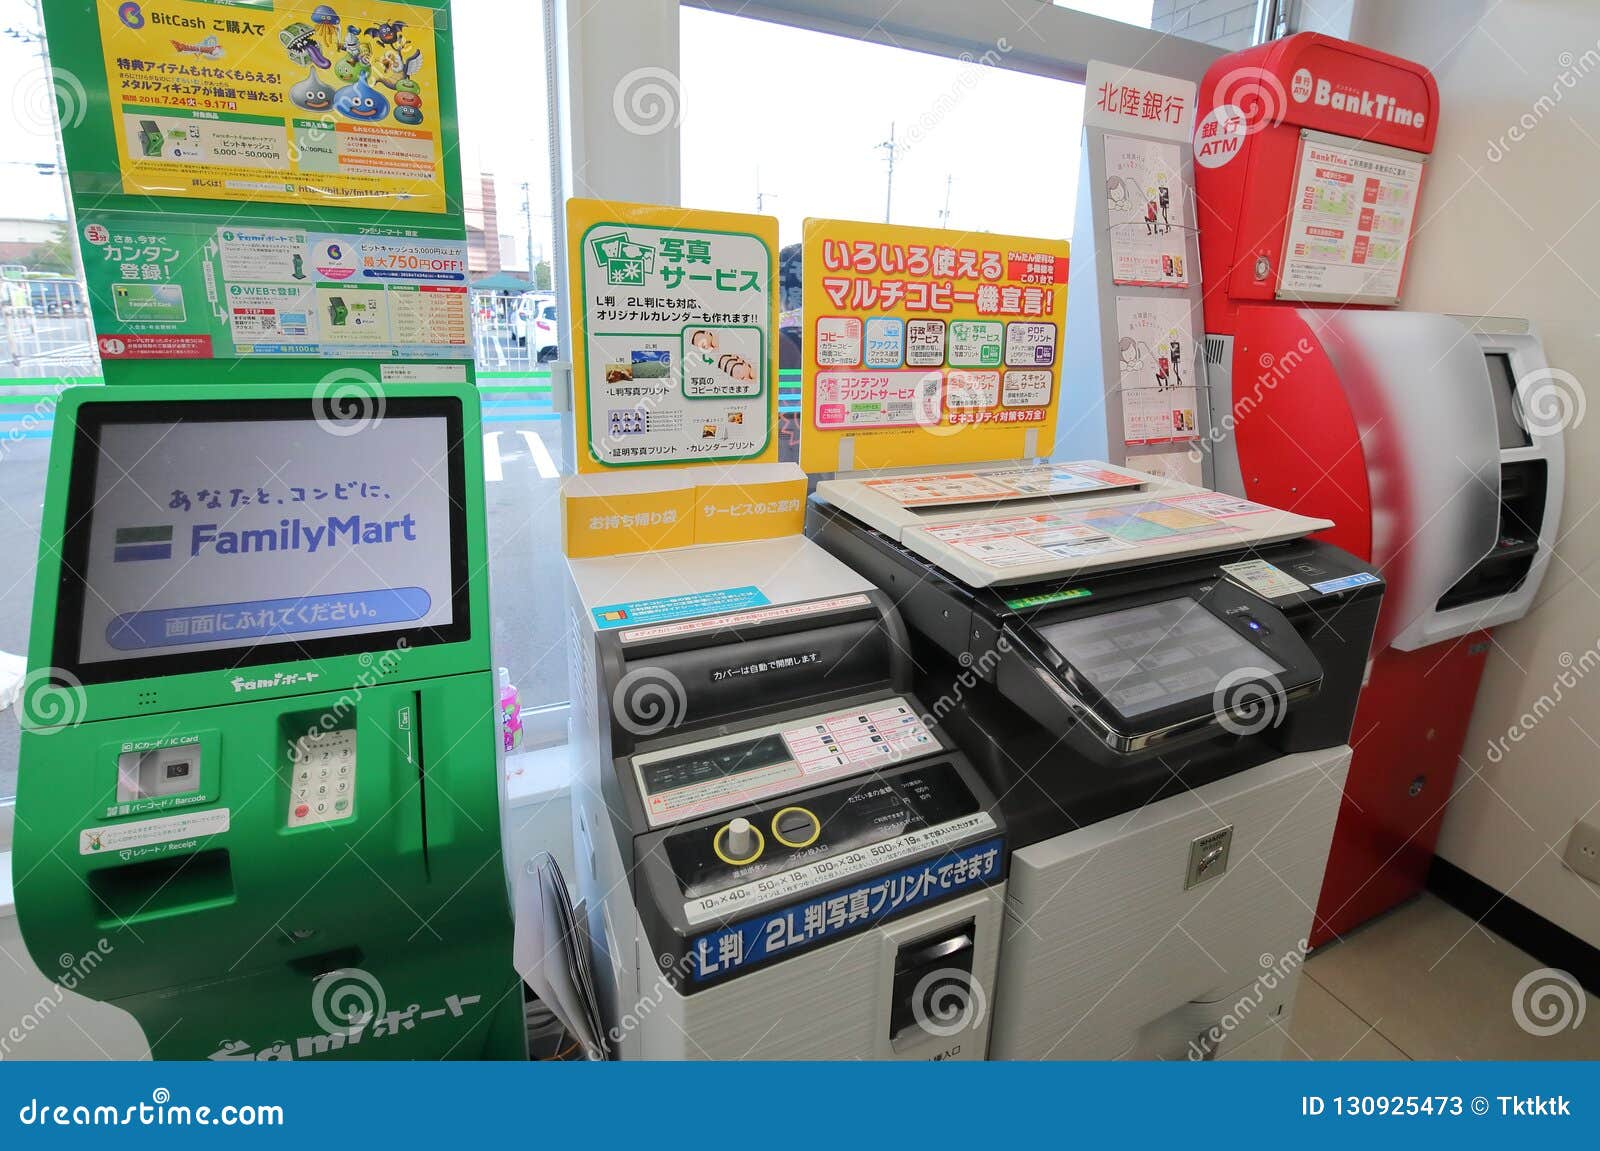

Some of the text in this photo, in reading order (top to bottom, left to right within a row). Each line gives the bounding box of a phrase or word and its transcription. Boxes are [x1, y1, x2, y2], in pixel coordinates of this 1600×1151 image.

[151, 12, 265, 36] BitCash ご購入で
[1293, 86, 1309, 97] ATM
[1096, 81, 1184, 125] 北陸銀行
[1314, 77, 1425, 130] BankTime
[1200, 116, 1240, 140] 銀行
[1199, 138, 1238, 158] ATM
[103, 246, 181, 263] カンタン
[658, 237, 713, 265] 写真
[363, 254, 463, 272] 最大750円OFF!
[822, 238, 1003, 283] いろいろ使える
[119, 263, 171, 281] 登録!
[659, 265, 763, 293] サービス
[243, 286, 301, 296] WEBで登録!
[822, 278, 1056, 318] マルチコピー機宣言!
[596, 295, 704, 310] L判 2L判にも対応、
[596, 310, 760, 324] オリジナルカレンダーも作れます!!
[821, 332, 845, 342] コピー
[910, 326, 926, 337] 行政
[910, 335, 939, 344] サービス
[972, 333, 1000, 342] サービス
[1028, 333, 1052, 342] プリント
[869, 340, 899, 350] ファクス
[690, 377, 714, 387] 写真の
[841, 377, 890, 389] コンテンツ
[1021, 374, 1046, 382] スキャン
[1021, 381, 1047, 390] サービス
[690, 386, 751, 395] コピーができます
[841, 388, 915, 401] プリントサービス
[169, 480, 392, 512] あなたと、コンビに、
[703, 498, 801, 519] サービスのご案内
[589, 509, 678, 531] お持ち帰り袋
[191, 513, 417, 558] FamilyMart
[165, 601, 377, 639] 画面にふれてください。
[171, 738, 178, 746] IC
[180, 735, 199, 744] Card
[131, 801, 168, 812] バーコード
[175, 794, 206, 805] Barcode
[133, 848, 163, 857] レシート
[168, 840, 198, 852] Receipt
[699, 930, 745, 979] L判
[765, 849, 1003, 956] 2L判写真プリントできます
